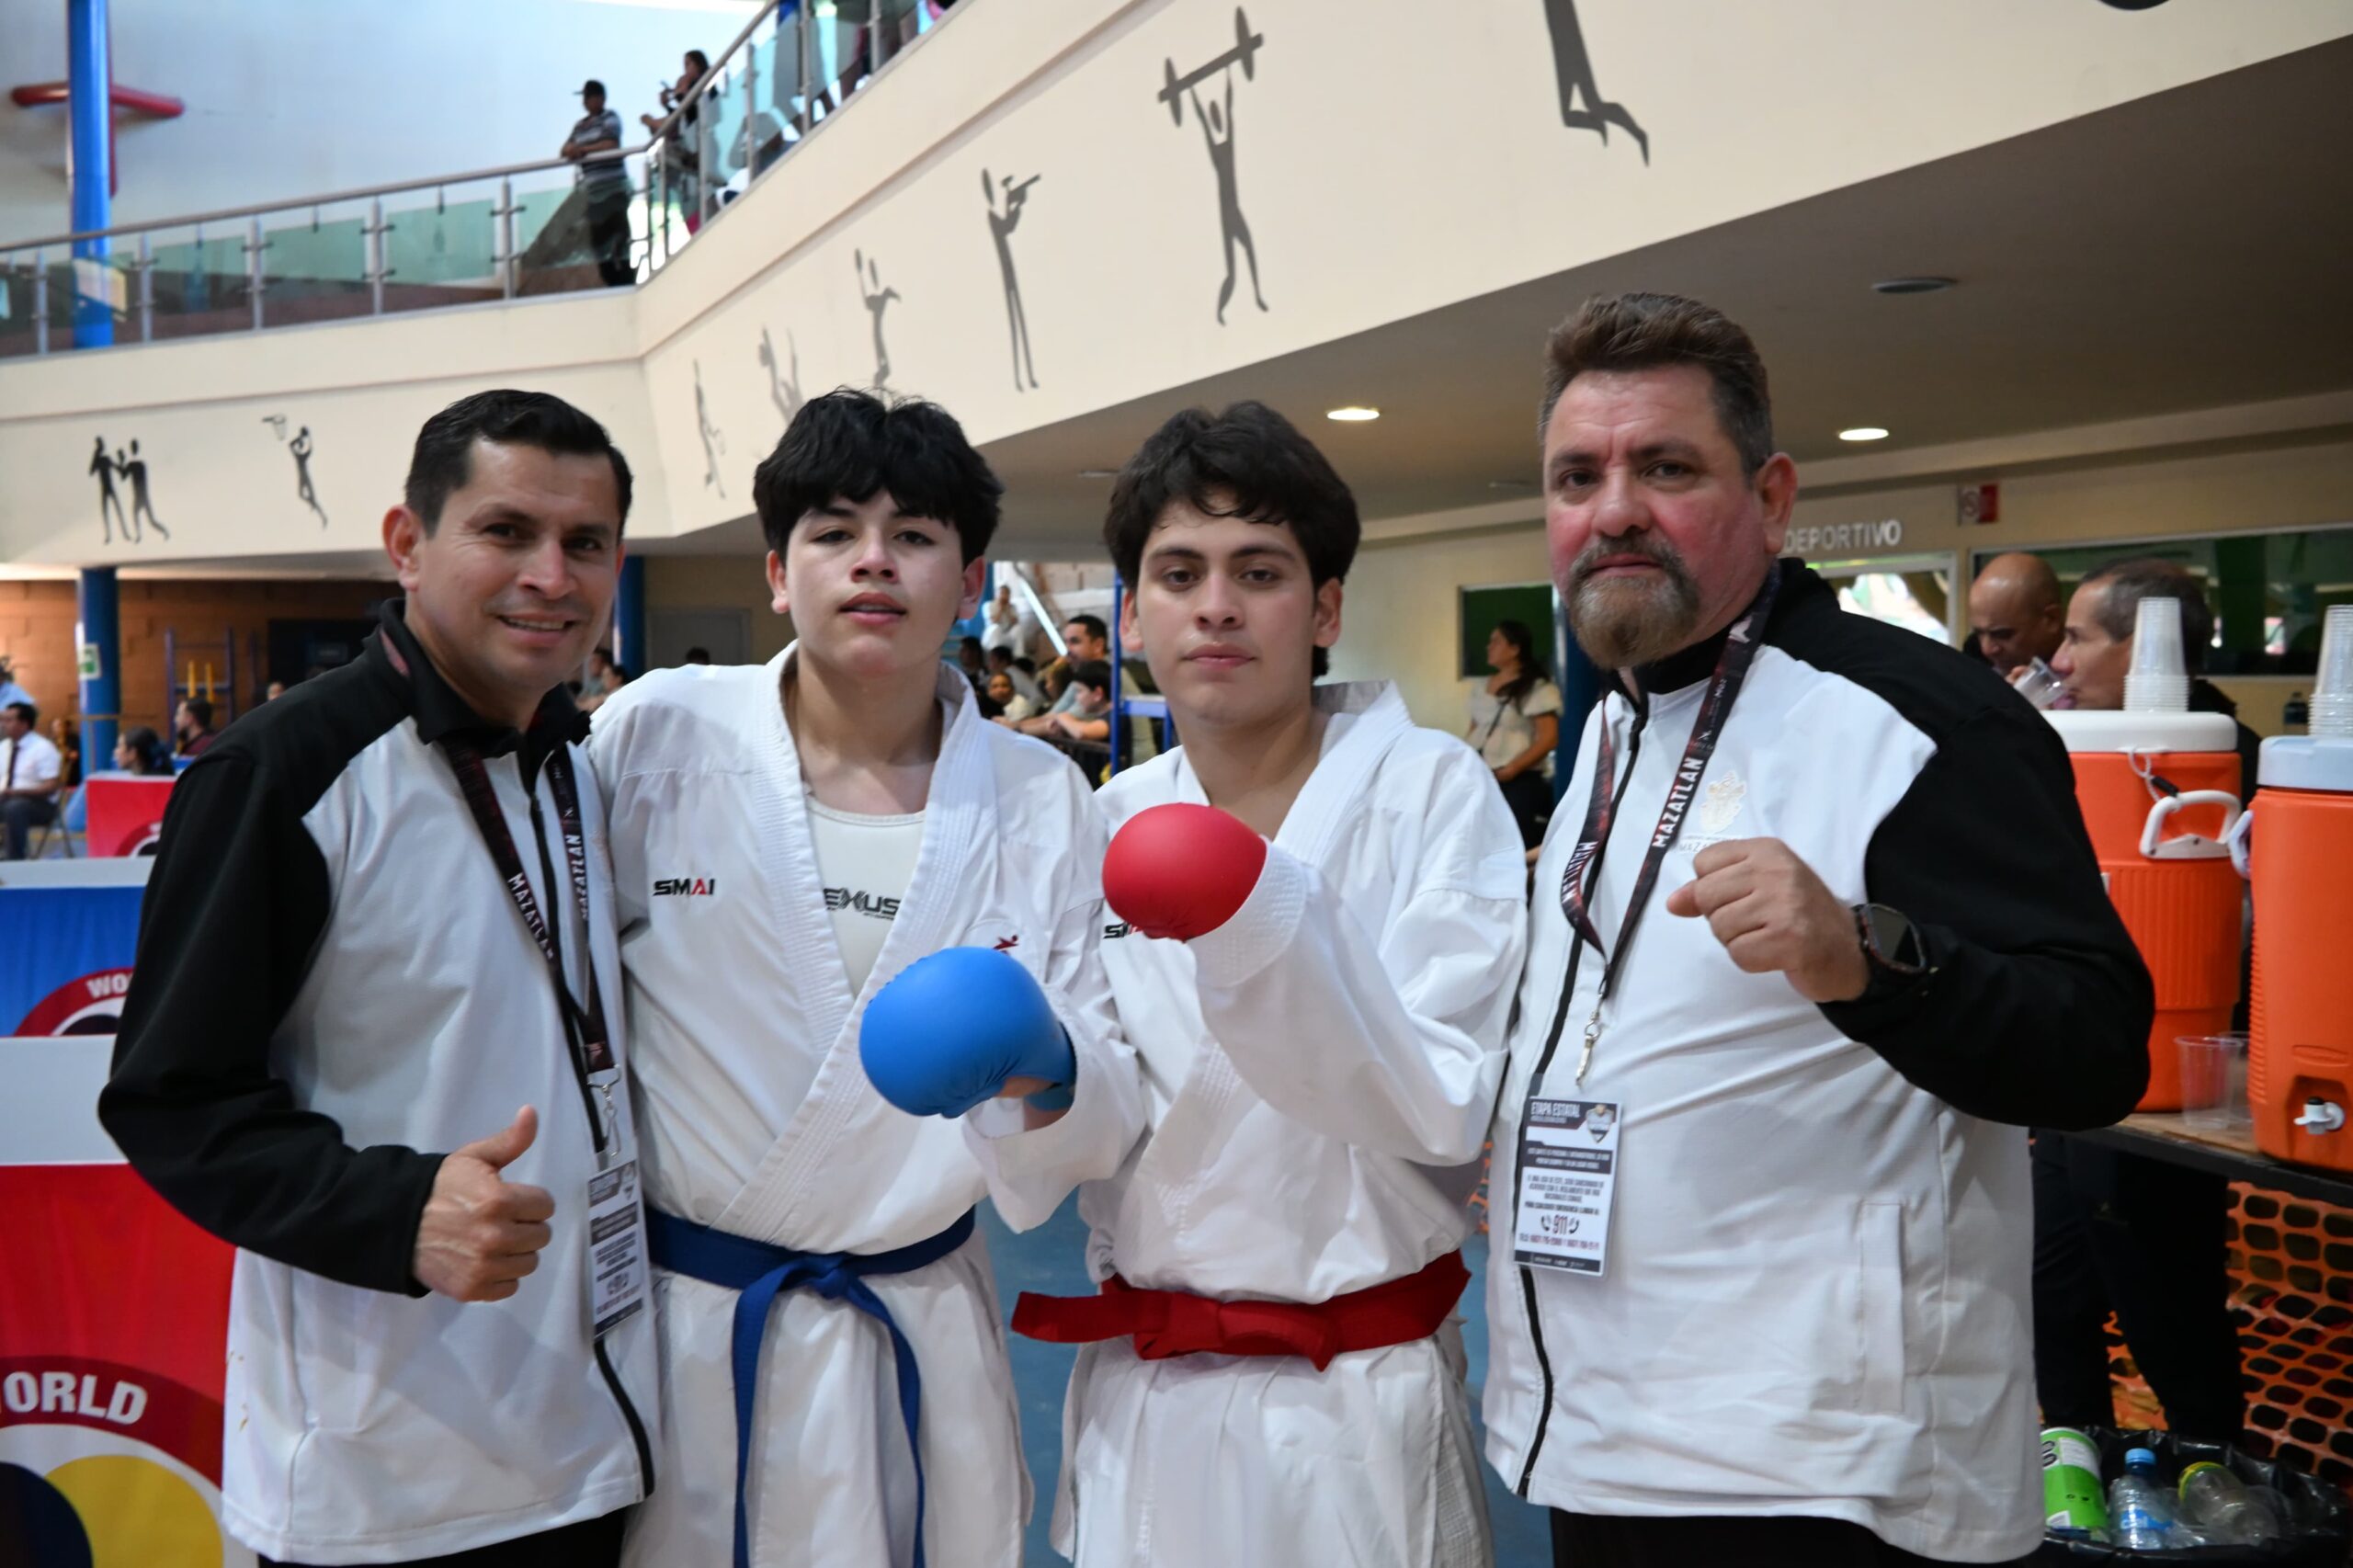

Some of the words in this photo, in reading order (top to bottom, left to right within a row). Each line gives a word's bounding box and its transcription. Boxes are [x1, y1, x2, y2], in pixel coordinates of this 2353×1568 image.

[1783, 519, 1902, 553] DEPORTIVO
[1652, 756, 1704, 847] MAZATLAN
[653, 878, 715, 896] SMAI
[824, 888, 902, 915] EXUS
[507, 872, 554, 960] MAZATLAN
[85, 972, 133, 999] WO
[1552, 1214, 1568, 1235] 911
[0, 1370, 148, 1426] ORLD
